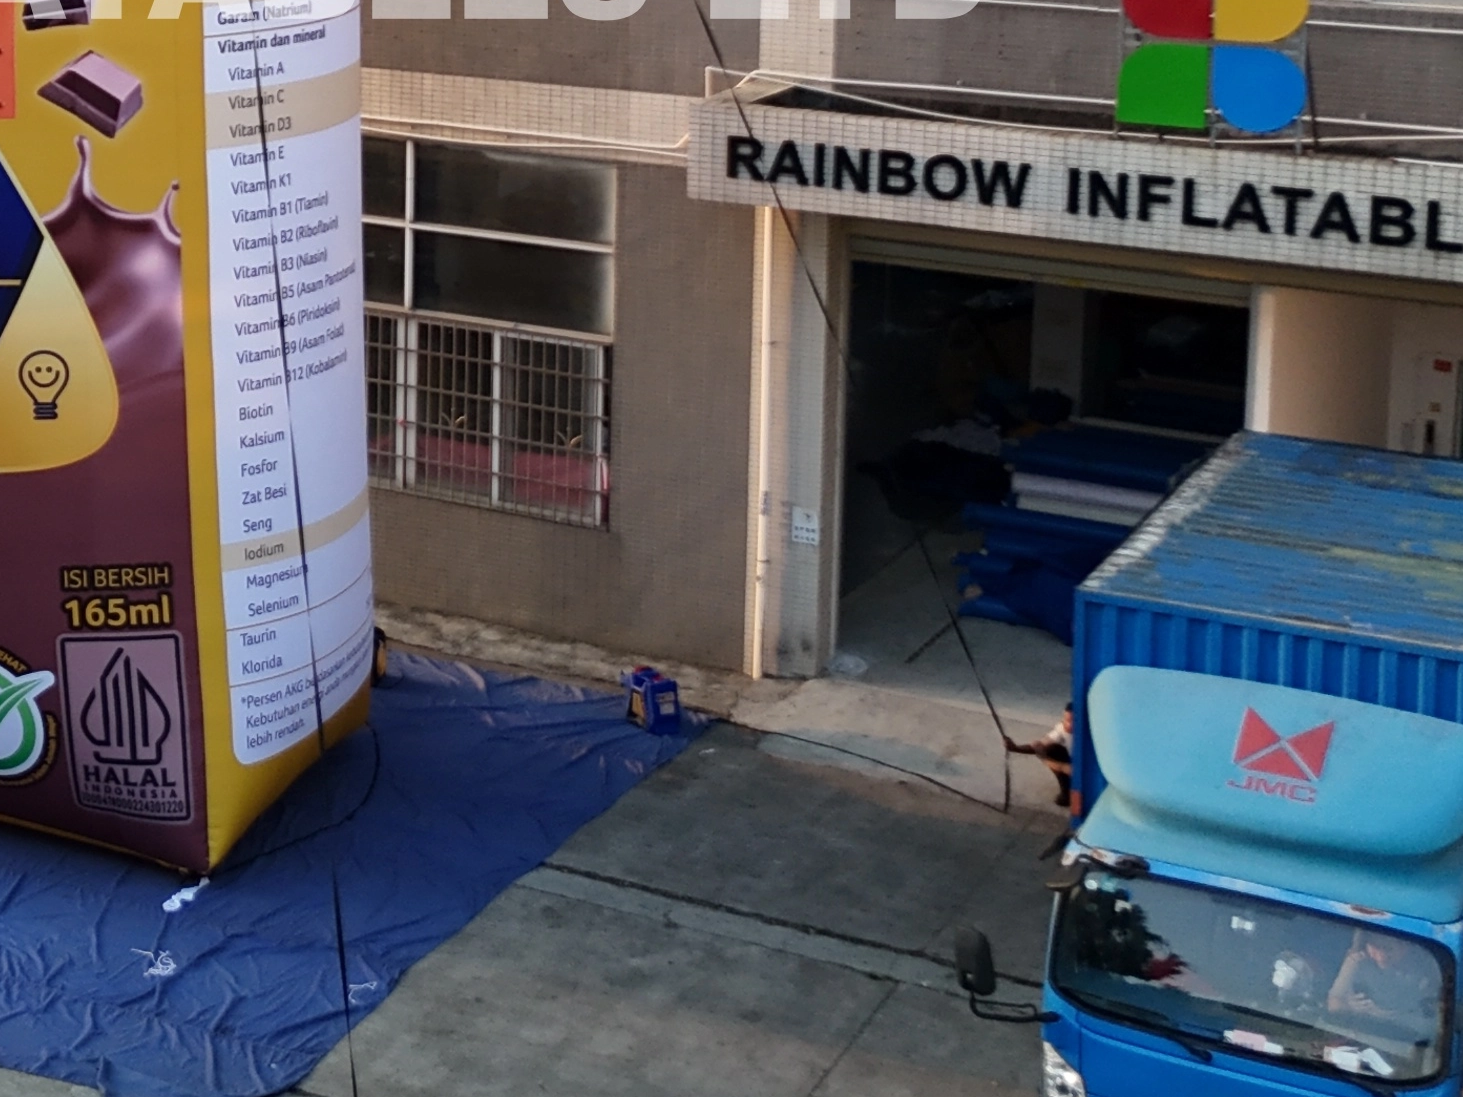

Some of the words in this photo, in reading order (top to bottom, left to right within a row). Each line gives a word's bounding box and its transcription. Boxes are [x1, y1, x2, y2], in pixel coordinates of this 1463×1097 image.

[217, 10, 260, 25] Garam
[263, 1, 312, 21] (Natrium)
[218, 36, 267, 54] Vitamin
[270, 34, 290, 48] dan
[293, 26, 326, 44] mineral
[276, 61, 284, 75] A
[276, 89, 284, 103] C
[278, 116, 292, 131] D3
[278, 145, 285, 159] E
[279, 173, 292, 189] K1
[726, 135, 1031, 208] RAINBOW
[1067, 165, 1463, 254] INFLATABL
[232, 206, 277, 224] Vitamin
[280, 200, 292, 216] B1
[232, 233, 278, 252] Vitamin
[280, 229, 293, 244] B2
[281, 257, 294, 272] B3
[281, 285, 294, 300] B5
[234, 317, 281, 336] Vitamin
[282, 312, 296, 328] B6
[236, 345, 281, 364] Vitamin
[237, 373, 283, 393] Vitamin
[285, 366, 304, 383] B12
[239, 403, 273, 421] Biotin
[240, 430, 285, 449] Kalsium
[241, 458, 278, 477] Fosfor
[242, 491, 262, 505] Zat
[264, 483, 287, 500] Besi
[243, 517, 273, 533] Seng
[244, 542, 284, 561] Iodium
[64, 570, 87, 589] ISI
[94, 567, 170, 588] BERSIH
[64, 594, 171, 627] 165ml
[248, 595, 299, 617] Selenium
[240, 629, 276, 647] Taurin
[241, 654, 282, 675] Klorida
[285, 679, 303, 697] AKG
[246, 702, 300, 729] Kebutuhan
[247, 731, 272, 749] lebih
[83, 765, 176, 787] HALAL
[84, 783, 178, 799] INDONESIA
[1227, 775, 1317, 803] JMC
